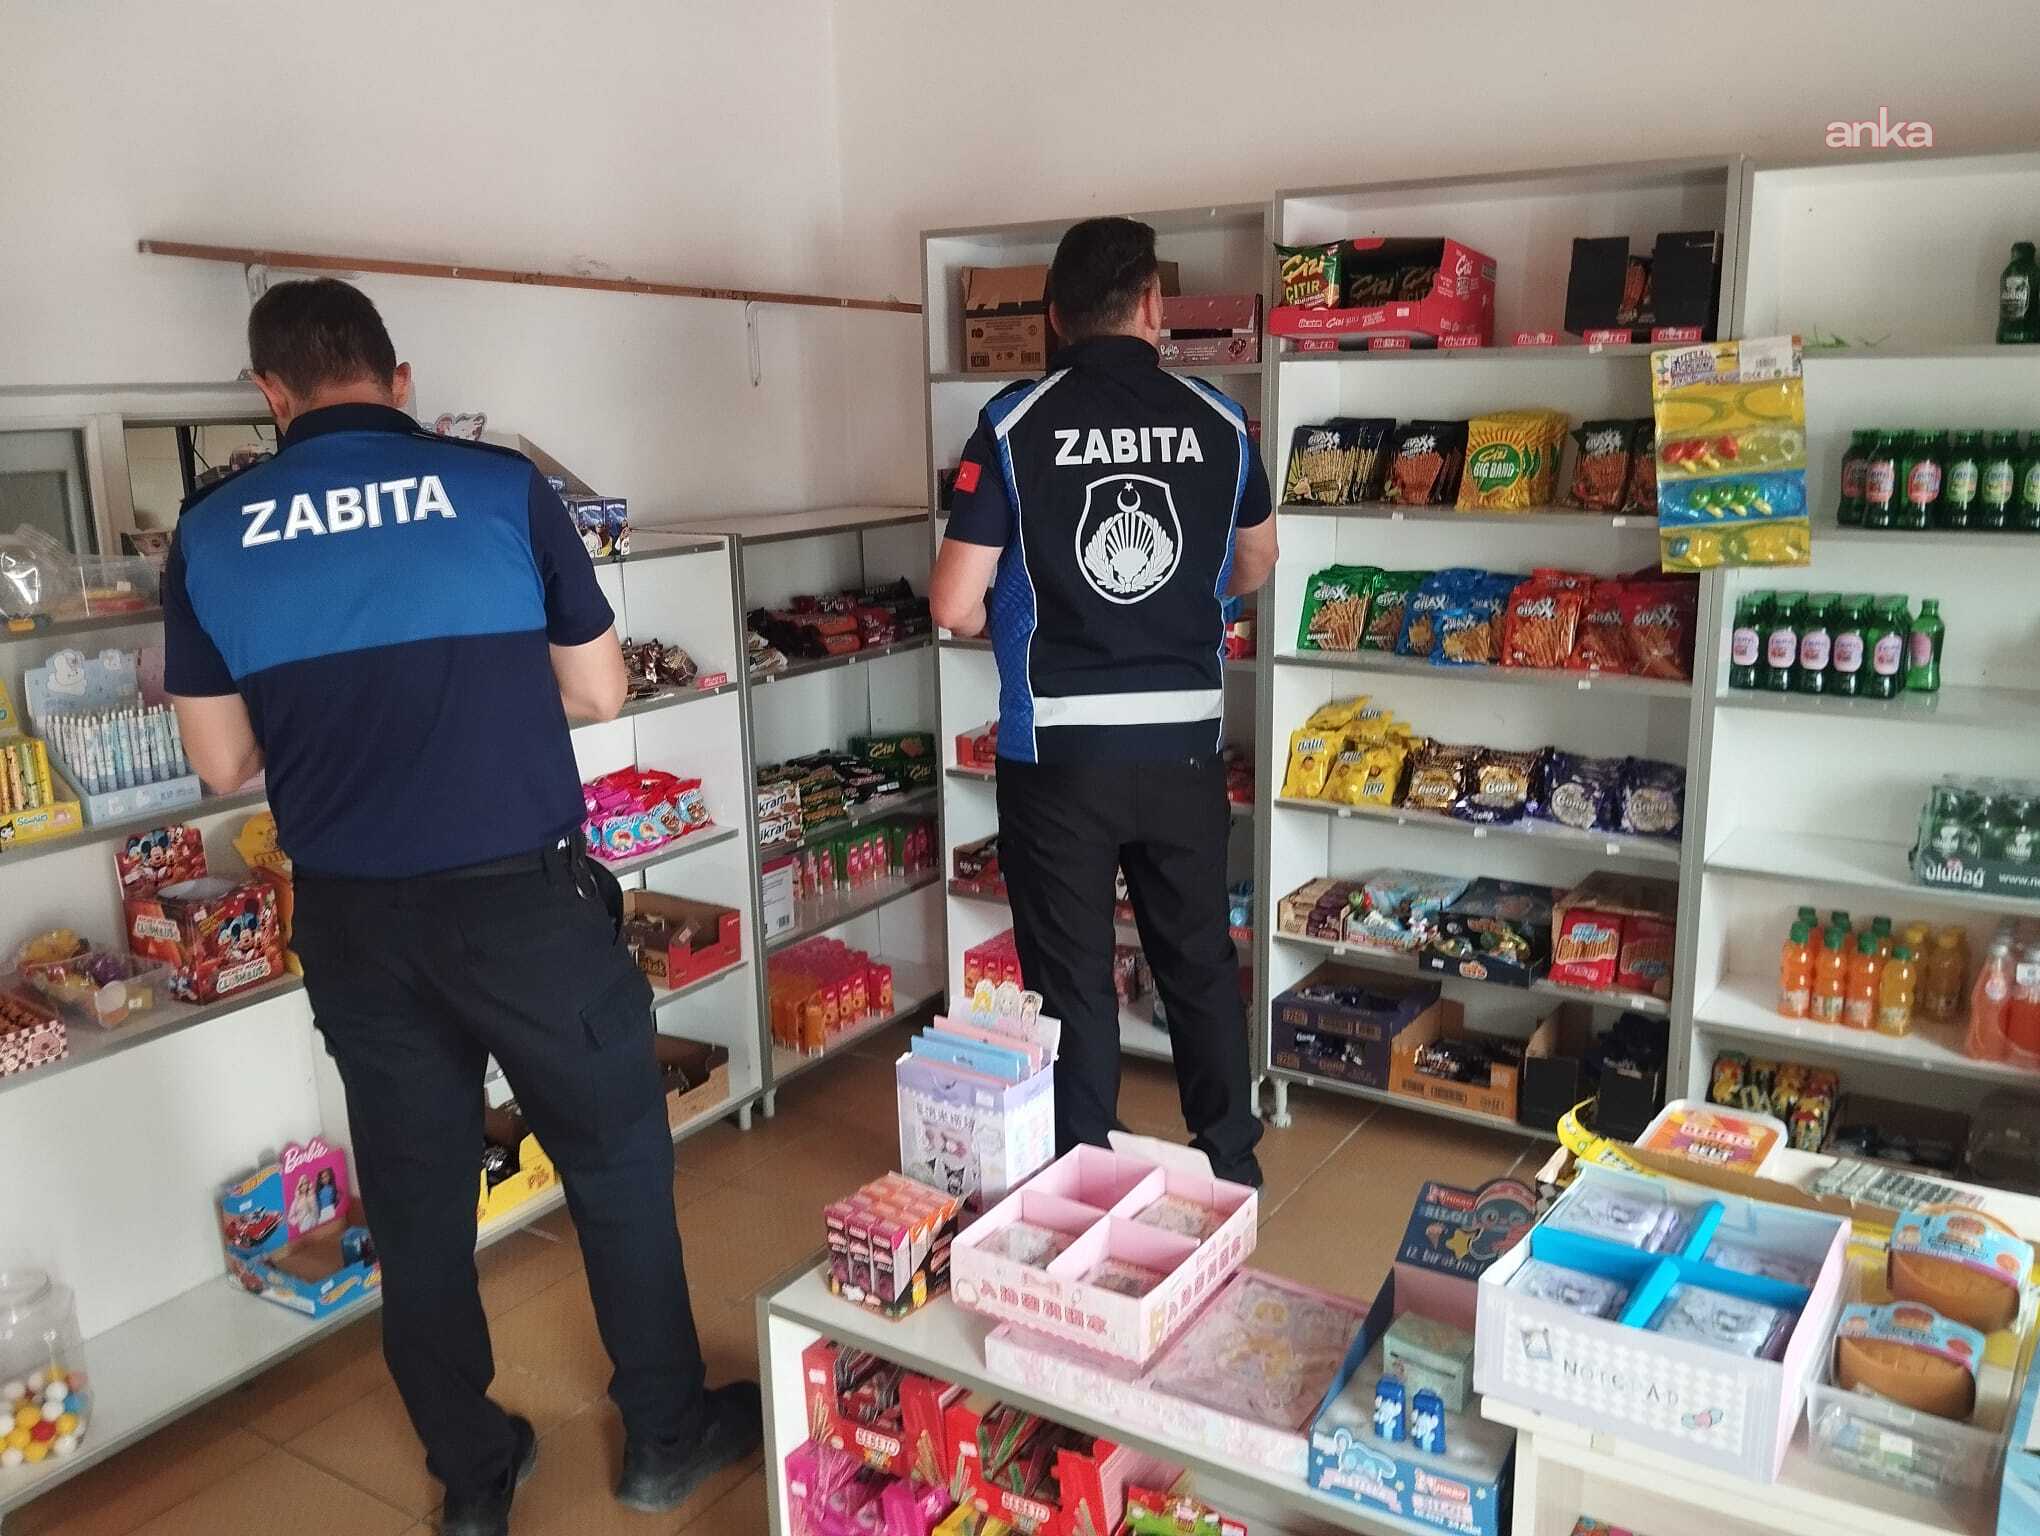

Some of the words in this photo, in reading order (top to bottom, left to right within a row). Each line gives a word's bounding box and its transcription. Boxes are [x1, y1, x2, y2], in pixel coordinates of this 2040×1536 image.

[1053, 427, 1204, 466] ZABITA
[1473, 462, 1490, 478] BIG
[1490, 462, 1515, 479] BAND
[241, 474, 458, 549] ZABITA
[758, 793, 787, 812] kram
[284, 1141, 328, 1174] Barbie
